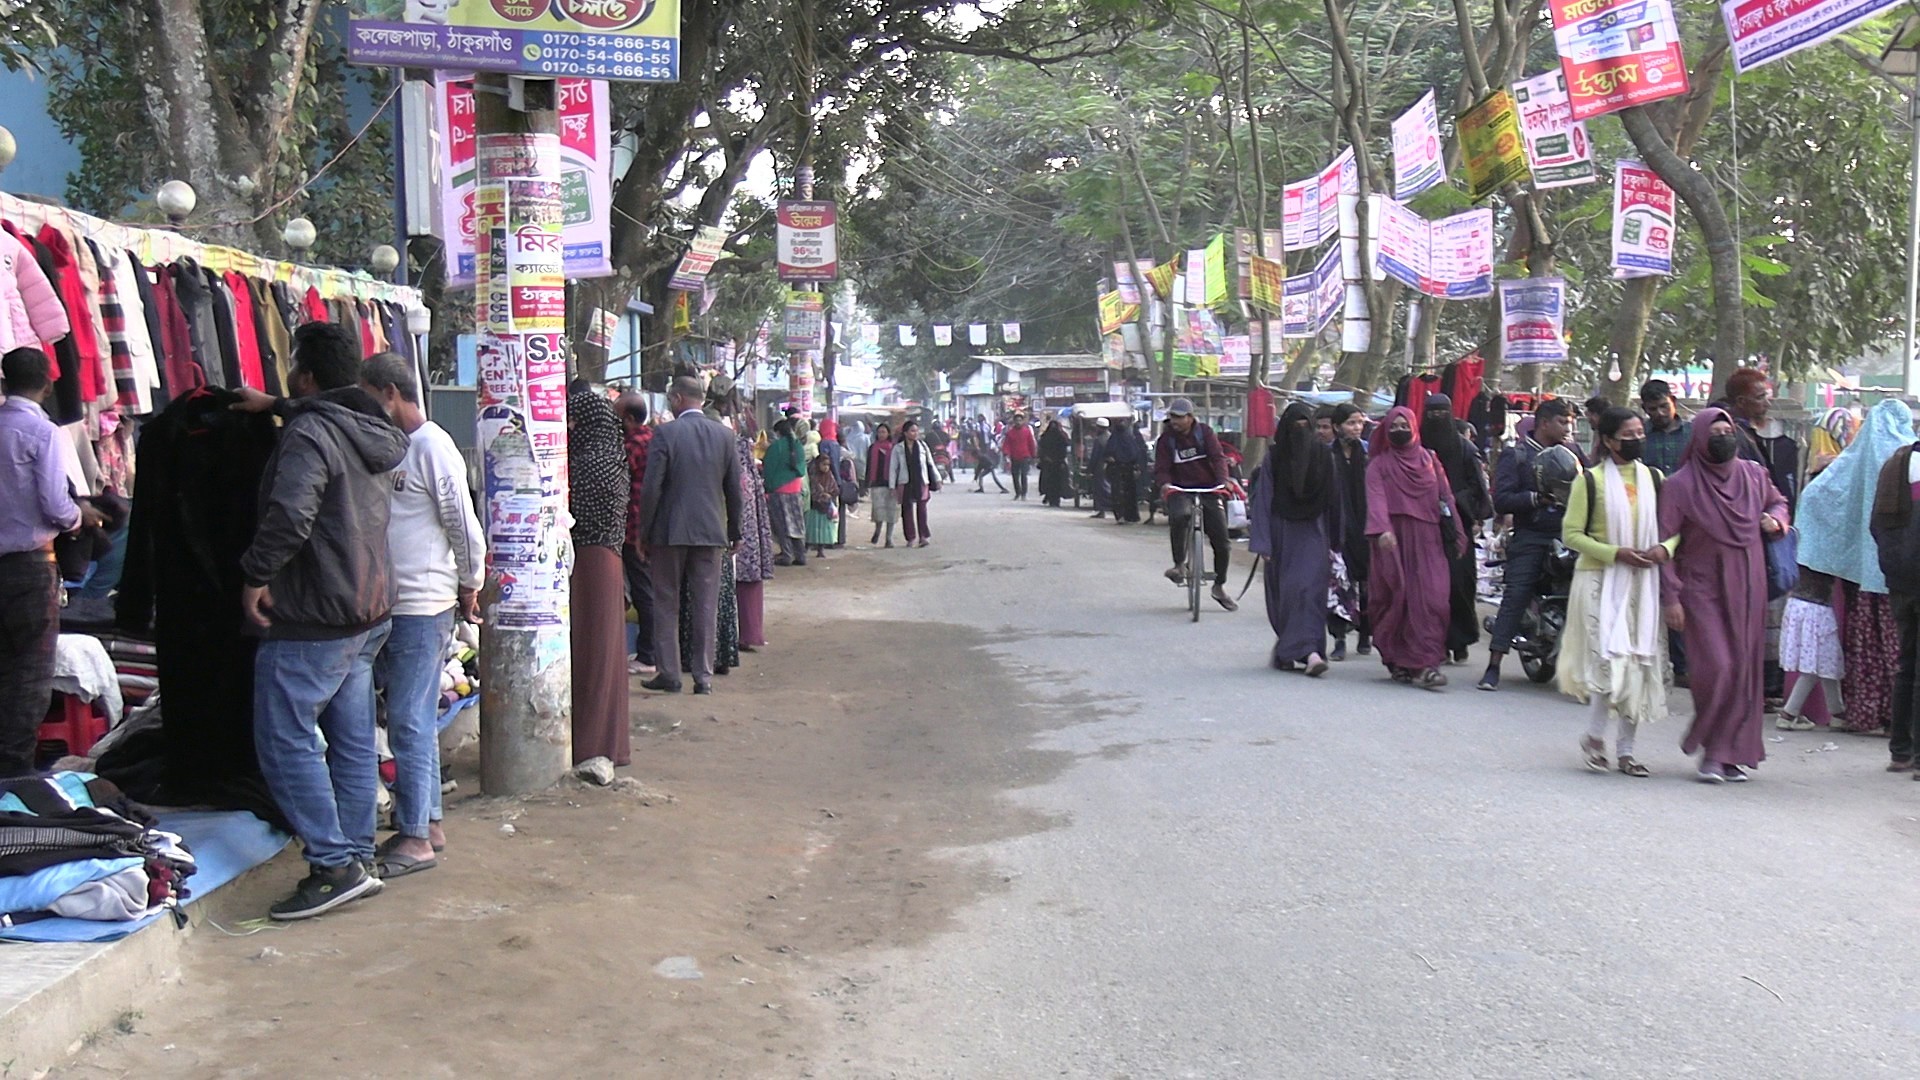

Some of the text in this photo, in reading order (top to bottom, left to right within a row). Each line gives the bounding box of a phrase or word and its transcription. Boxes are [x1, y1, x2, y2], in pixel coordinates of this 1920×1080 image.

[356, 27, 512, 55] কলেজপাড়া, ঠাকুরগাঁও
[543, 33, 671, 51] 0170-54-666-54
[543, 47, 671, 65] 0170-54-666-55
[542, 61, 671, 79] 0170-54-666-56
[1571, 64, 1639, 97] উদ্ভাস
